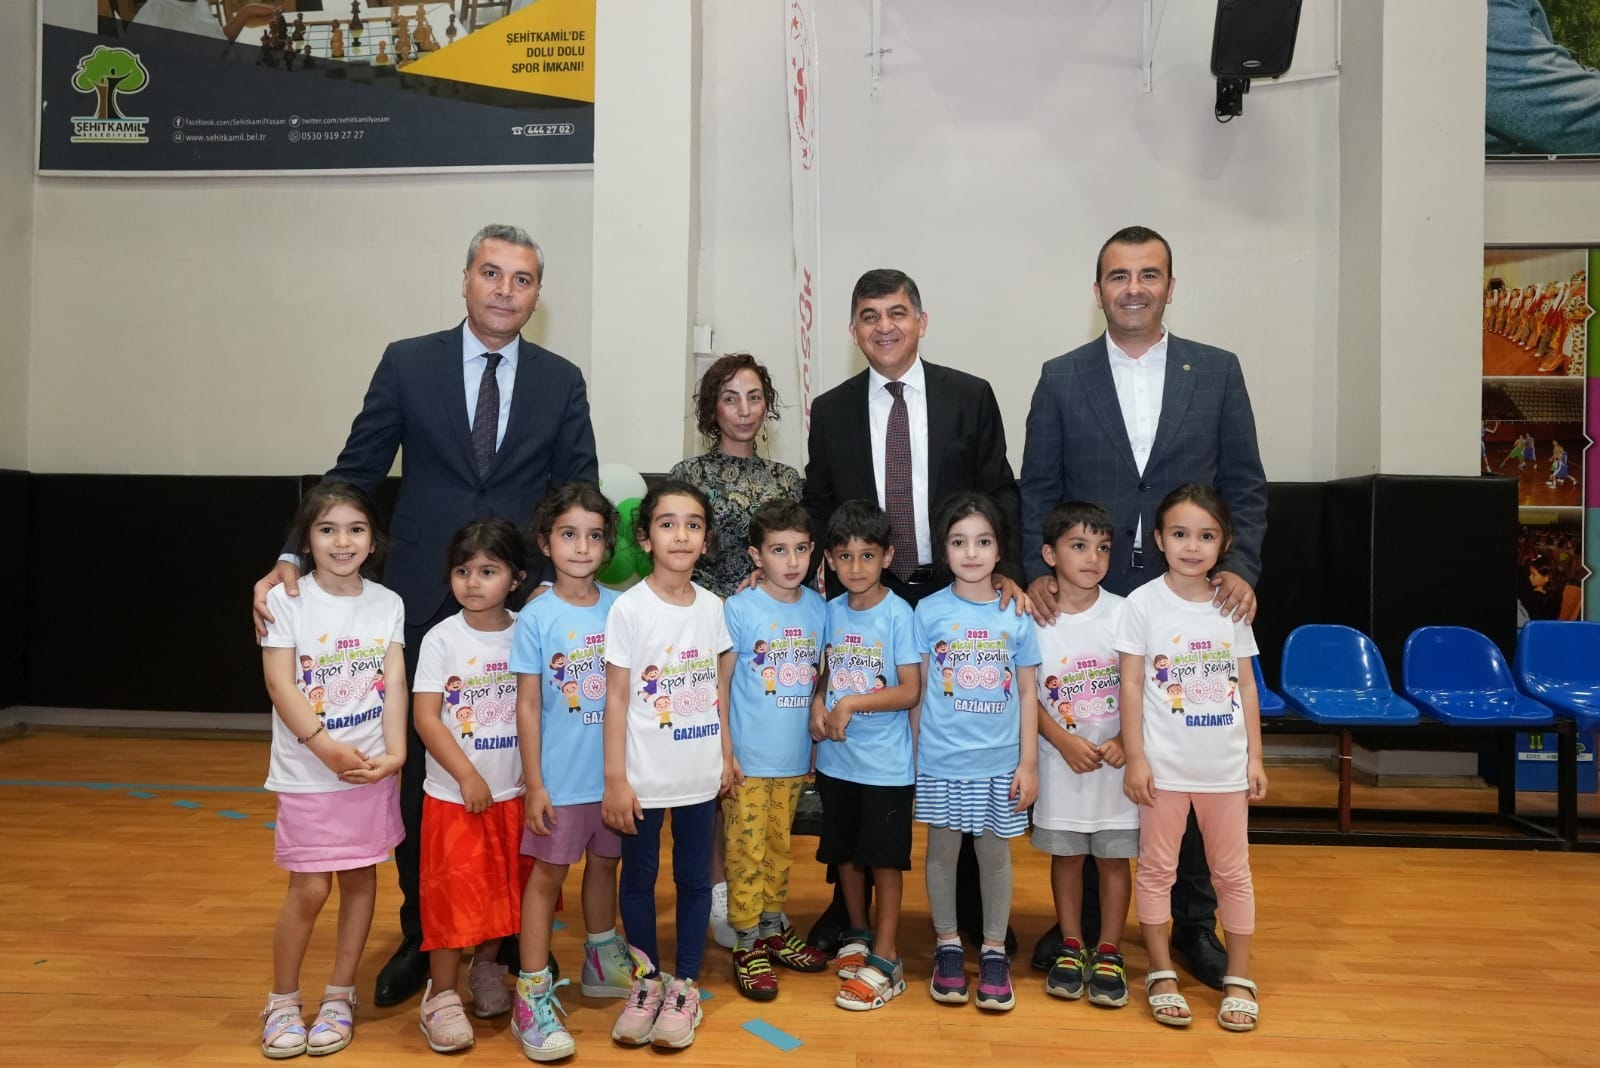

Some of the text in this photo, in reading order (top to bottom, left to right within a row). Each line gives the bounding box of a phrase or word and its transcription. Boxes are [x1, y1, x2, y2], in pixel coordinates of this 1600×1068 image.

[506, 29, 586, 45] ŞEHİTKAMİL'DE
[526, 46, 585, 58] DOLU DOLU
[511, 60, 584, 73] SPOR İMKANI!
[527, 125, 570, 134] 444 27 02
[185, 133, 266, 142] www.sehitkamil.bel.tr
[301, 130, 364, 140] 0530 919 27 27
[785, 629, 802, 637] 2023
[967, 630, 988, 639] 2023
[338, 639, 361, 649] 2023
[845, 635, 862, 644] 2023
[1190, 641, 1212, 650] 2023
[680, 649, 699, 660] 2023
[486, 662, 508, 672] 2023
[1077, 660, 1097, 669] 2023
[777, 695, 810, 708] GAZİANT
[955, 698, 1006, 713] GAZİANTEP
[327, 705, 383, 730] GAZİANTEP
[1186, 713, 1233, 727] GAZİANTEP
[674, 723, 719, 741] GAZİANTEP
[474, 735, 518, 750] GAZİANT
